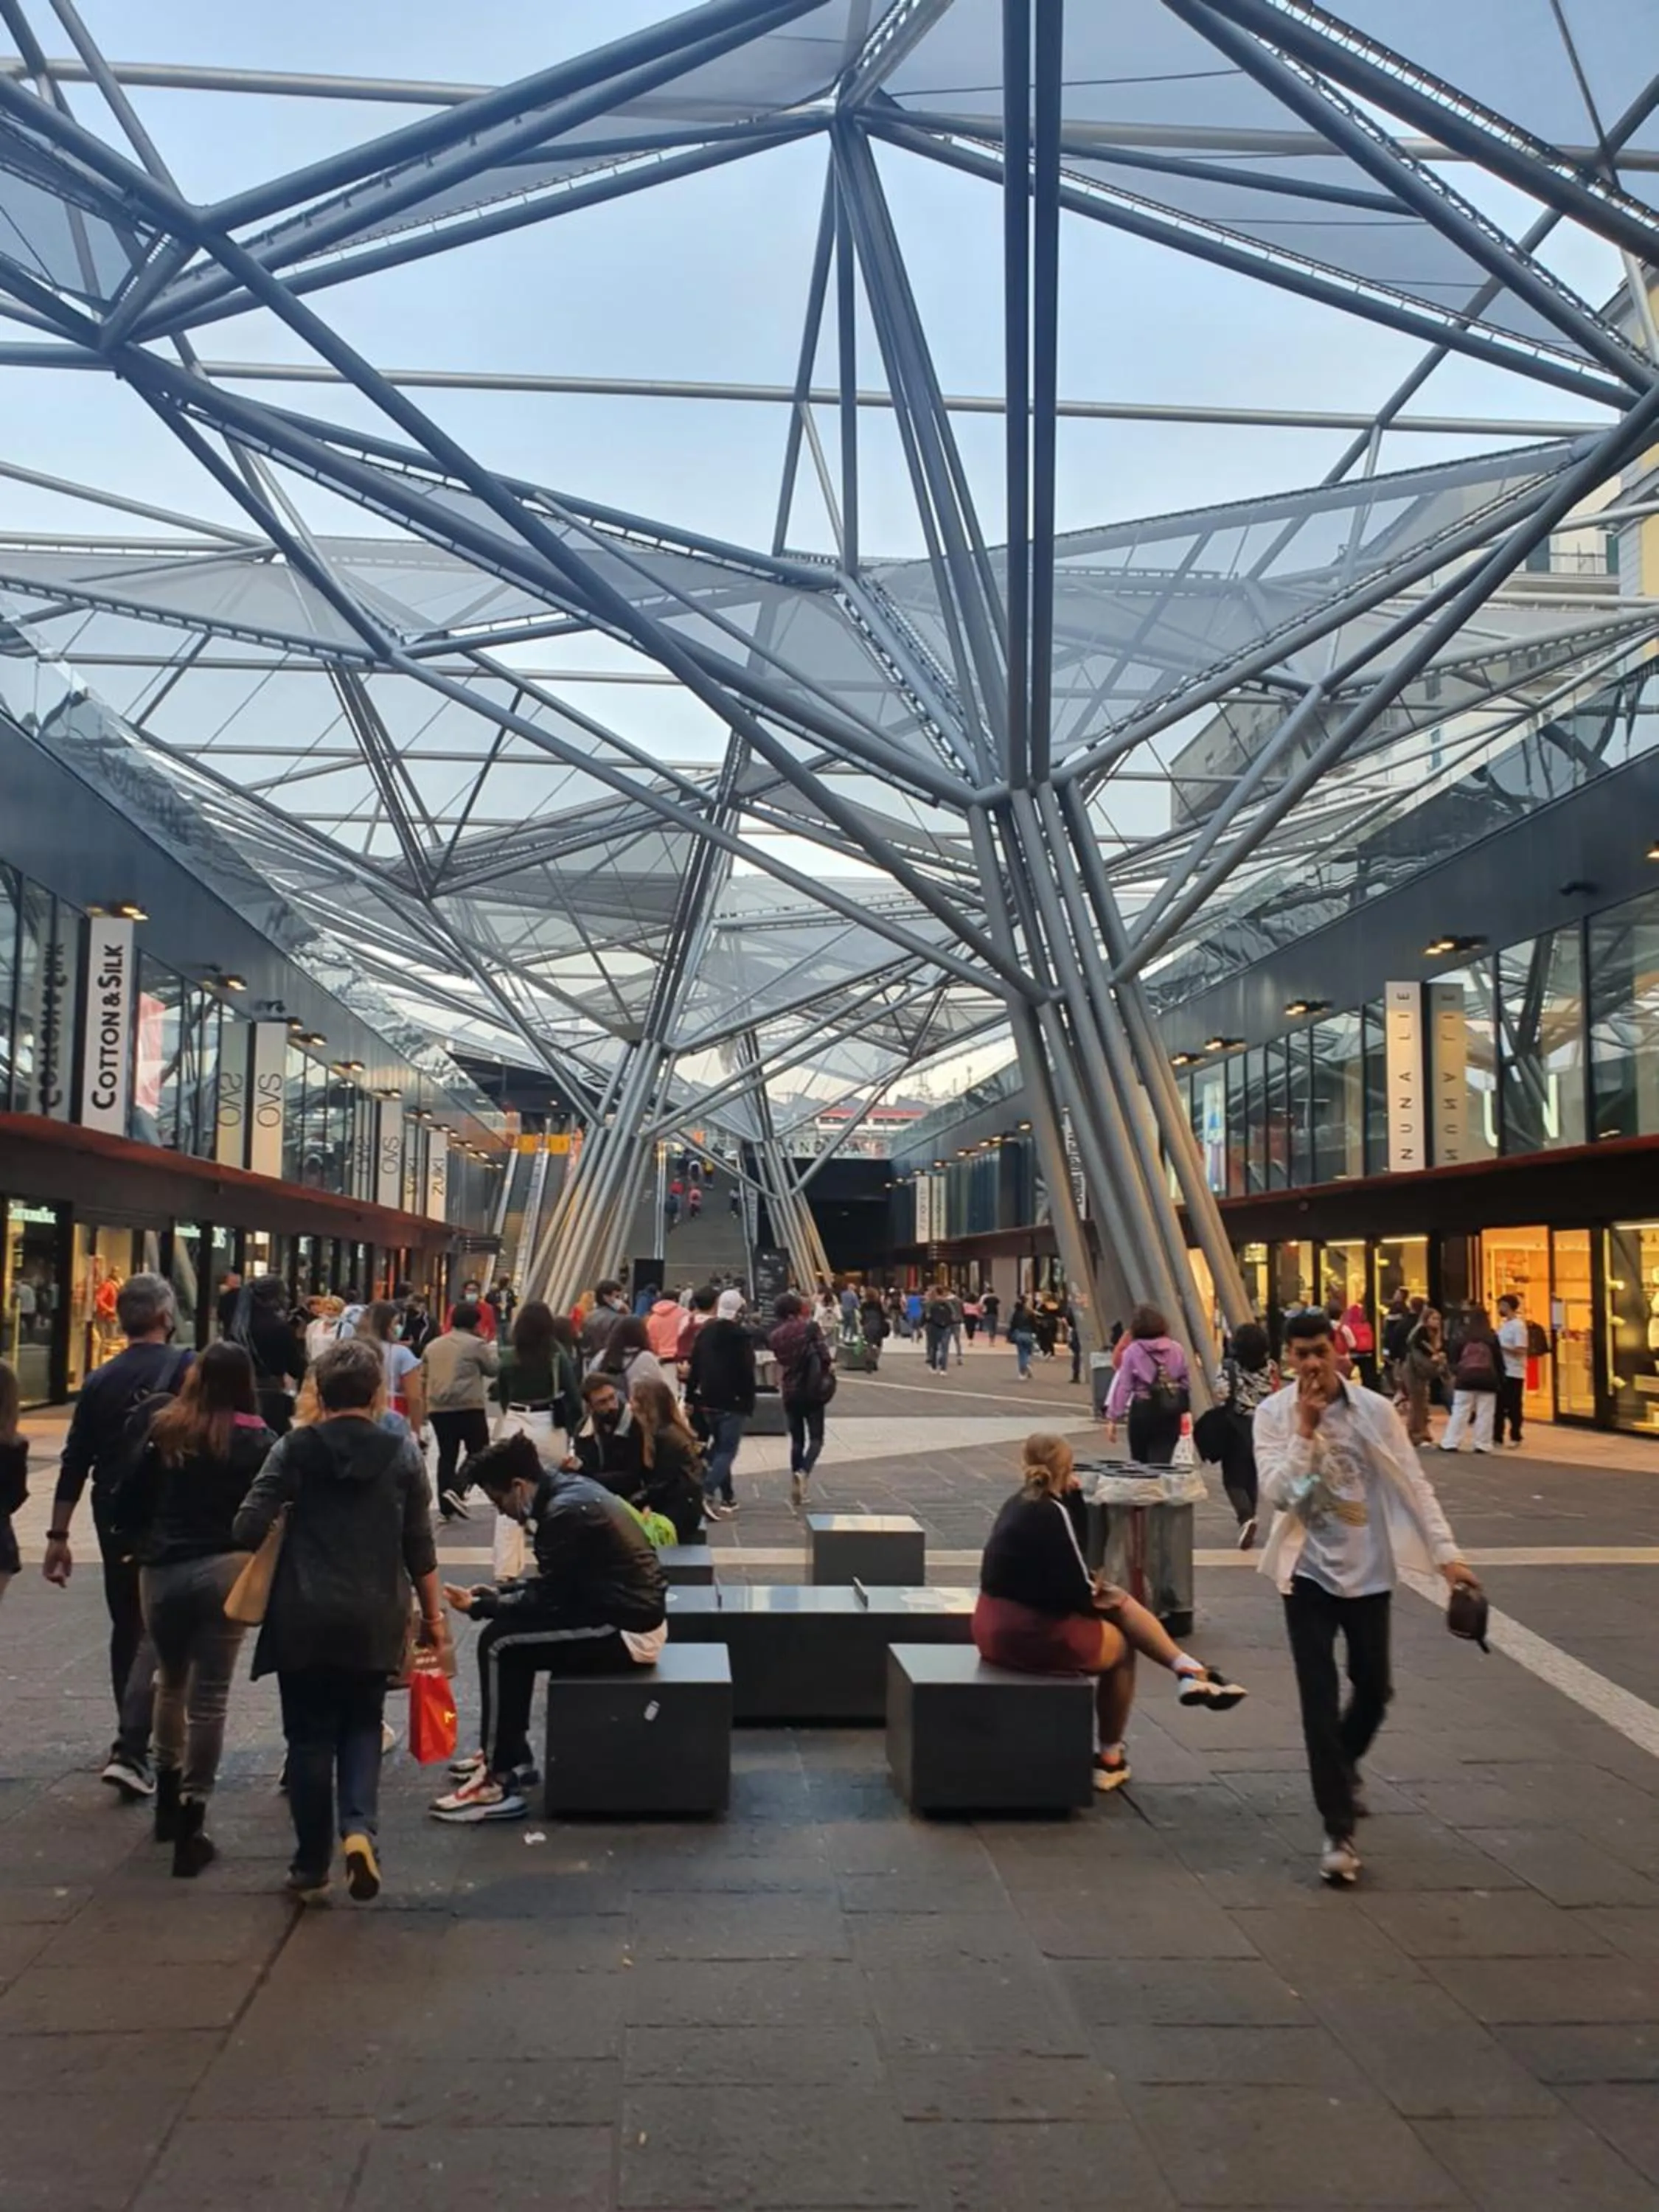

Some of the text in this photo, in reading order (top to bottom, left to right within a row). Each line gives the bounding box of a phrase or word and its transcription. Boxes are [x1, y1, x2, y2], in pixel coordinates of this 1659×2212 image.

[102, 992, 120, 1007] &
[1397, 992, 1413, 1161] NUNA LIE
[256, 1073, 282, 1128] OVS
[381, 1136, 400, 1175] OVS
